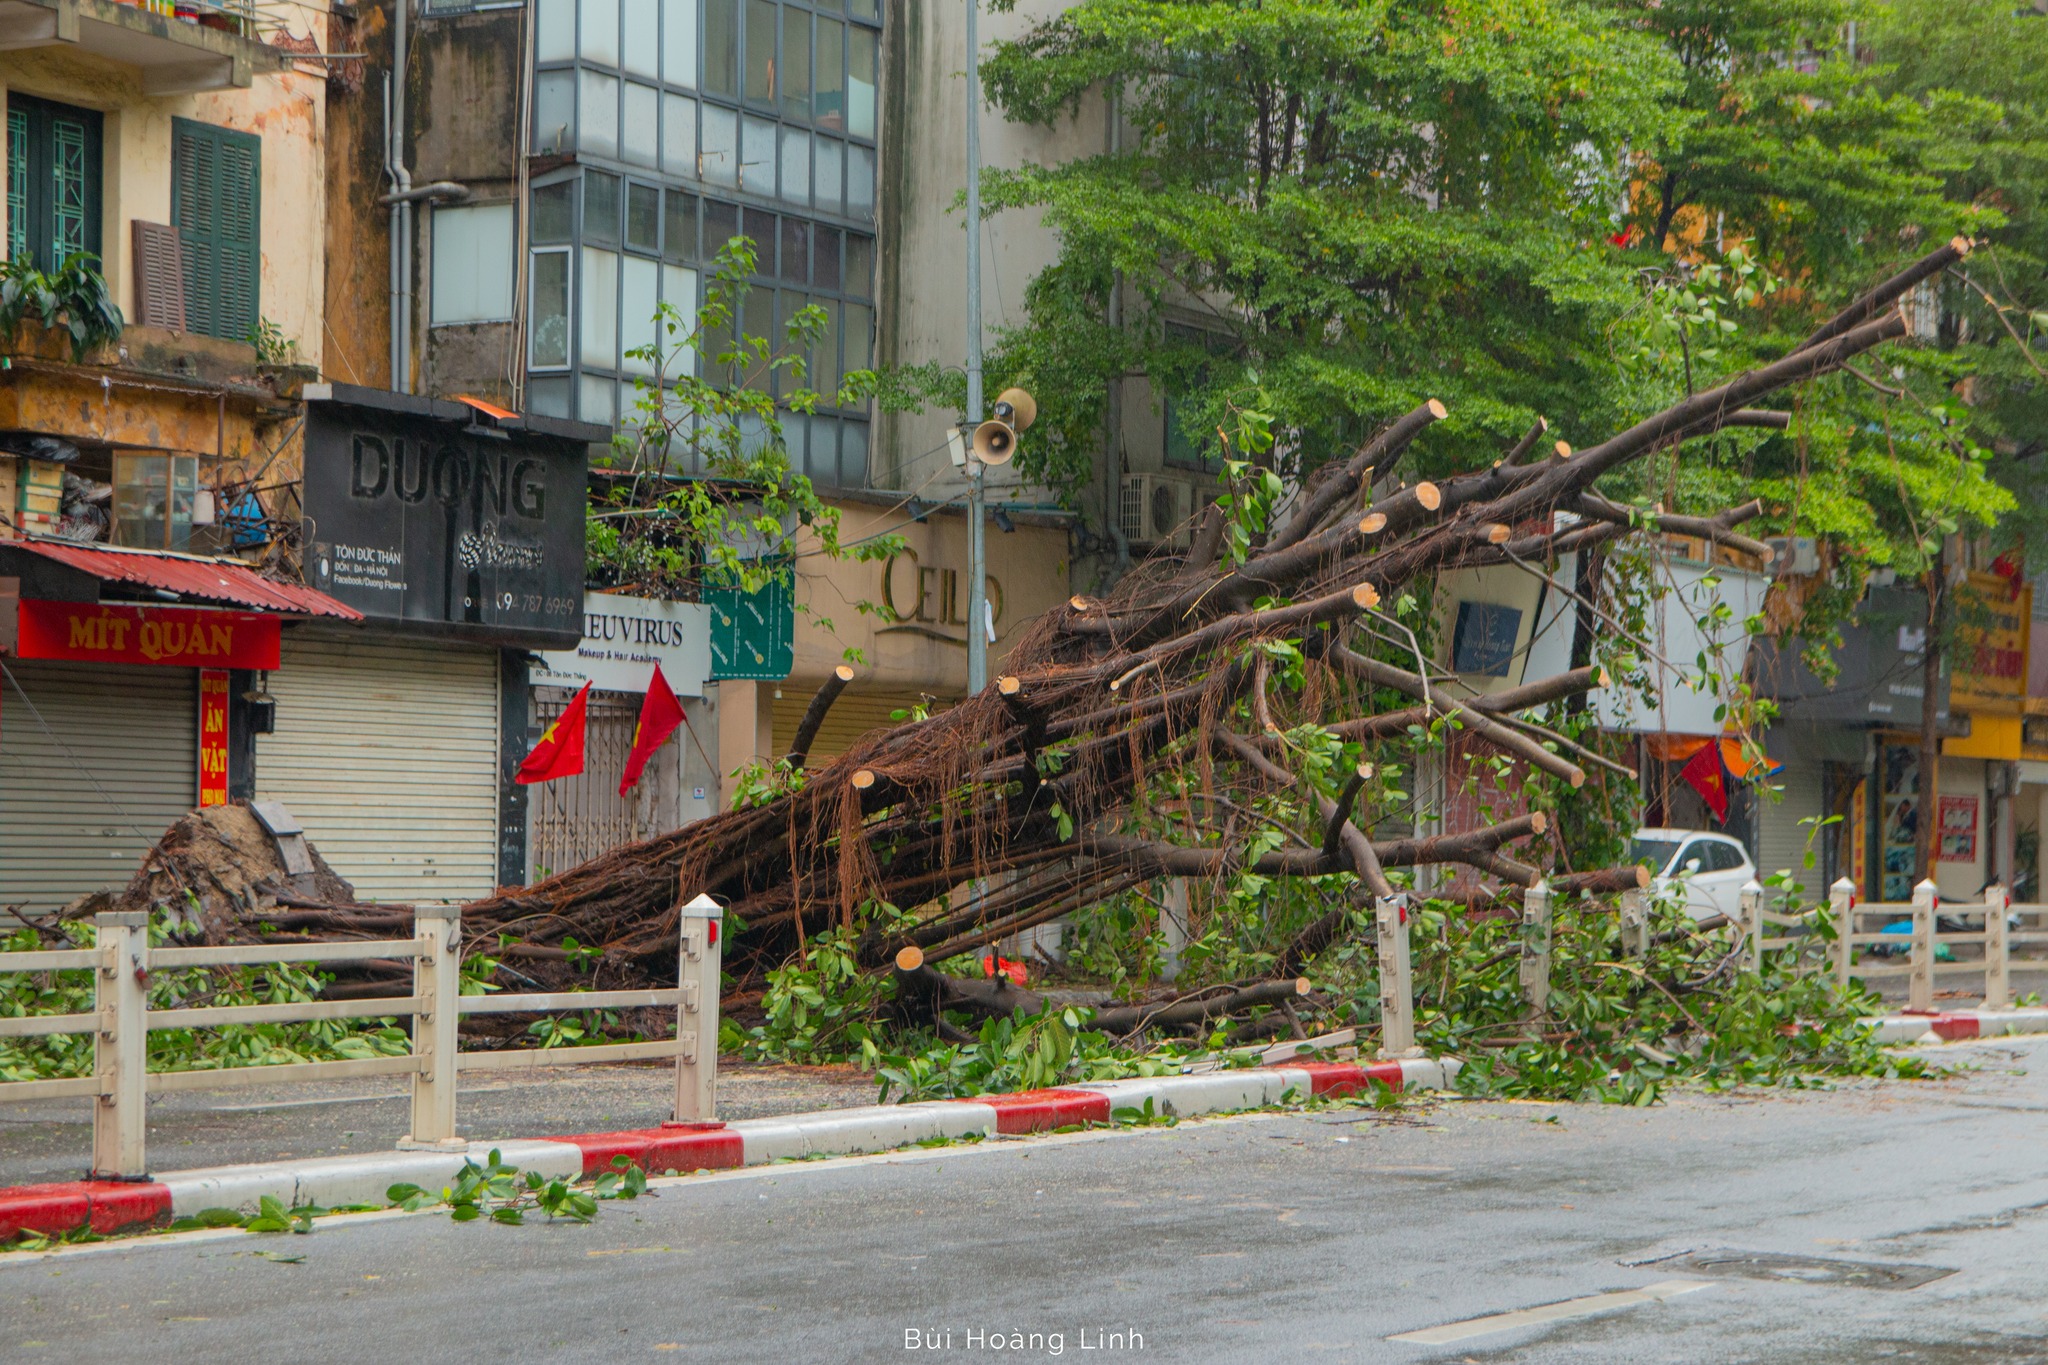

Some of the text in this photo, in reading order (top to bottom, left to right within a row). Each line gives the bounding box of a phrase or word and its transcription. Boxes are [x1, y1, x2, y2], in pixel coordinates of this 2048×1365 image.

[68, 607, 132, 650] MÍT
[578, 647, 605, 660] Makeup
[614, 651, 628, 661] Hair
[205, 701, 224, 733] ĂN
